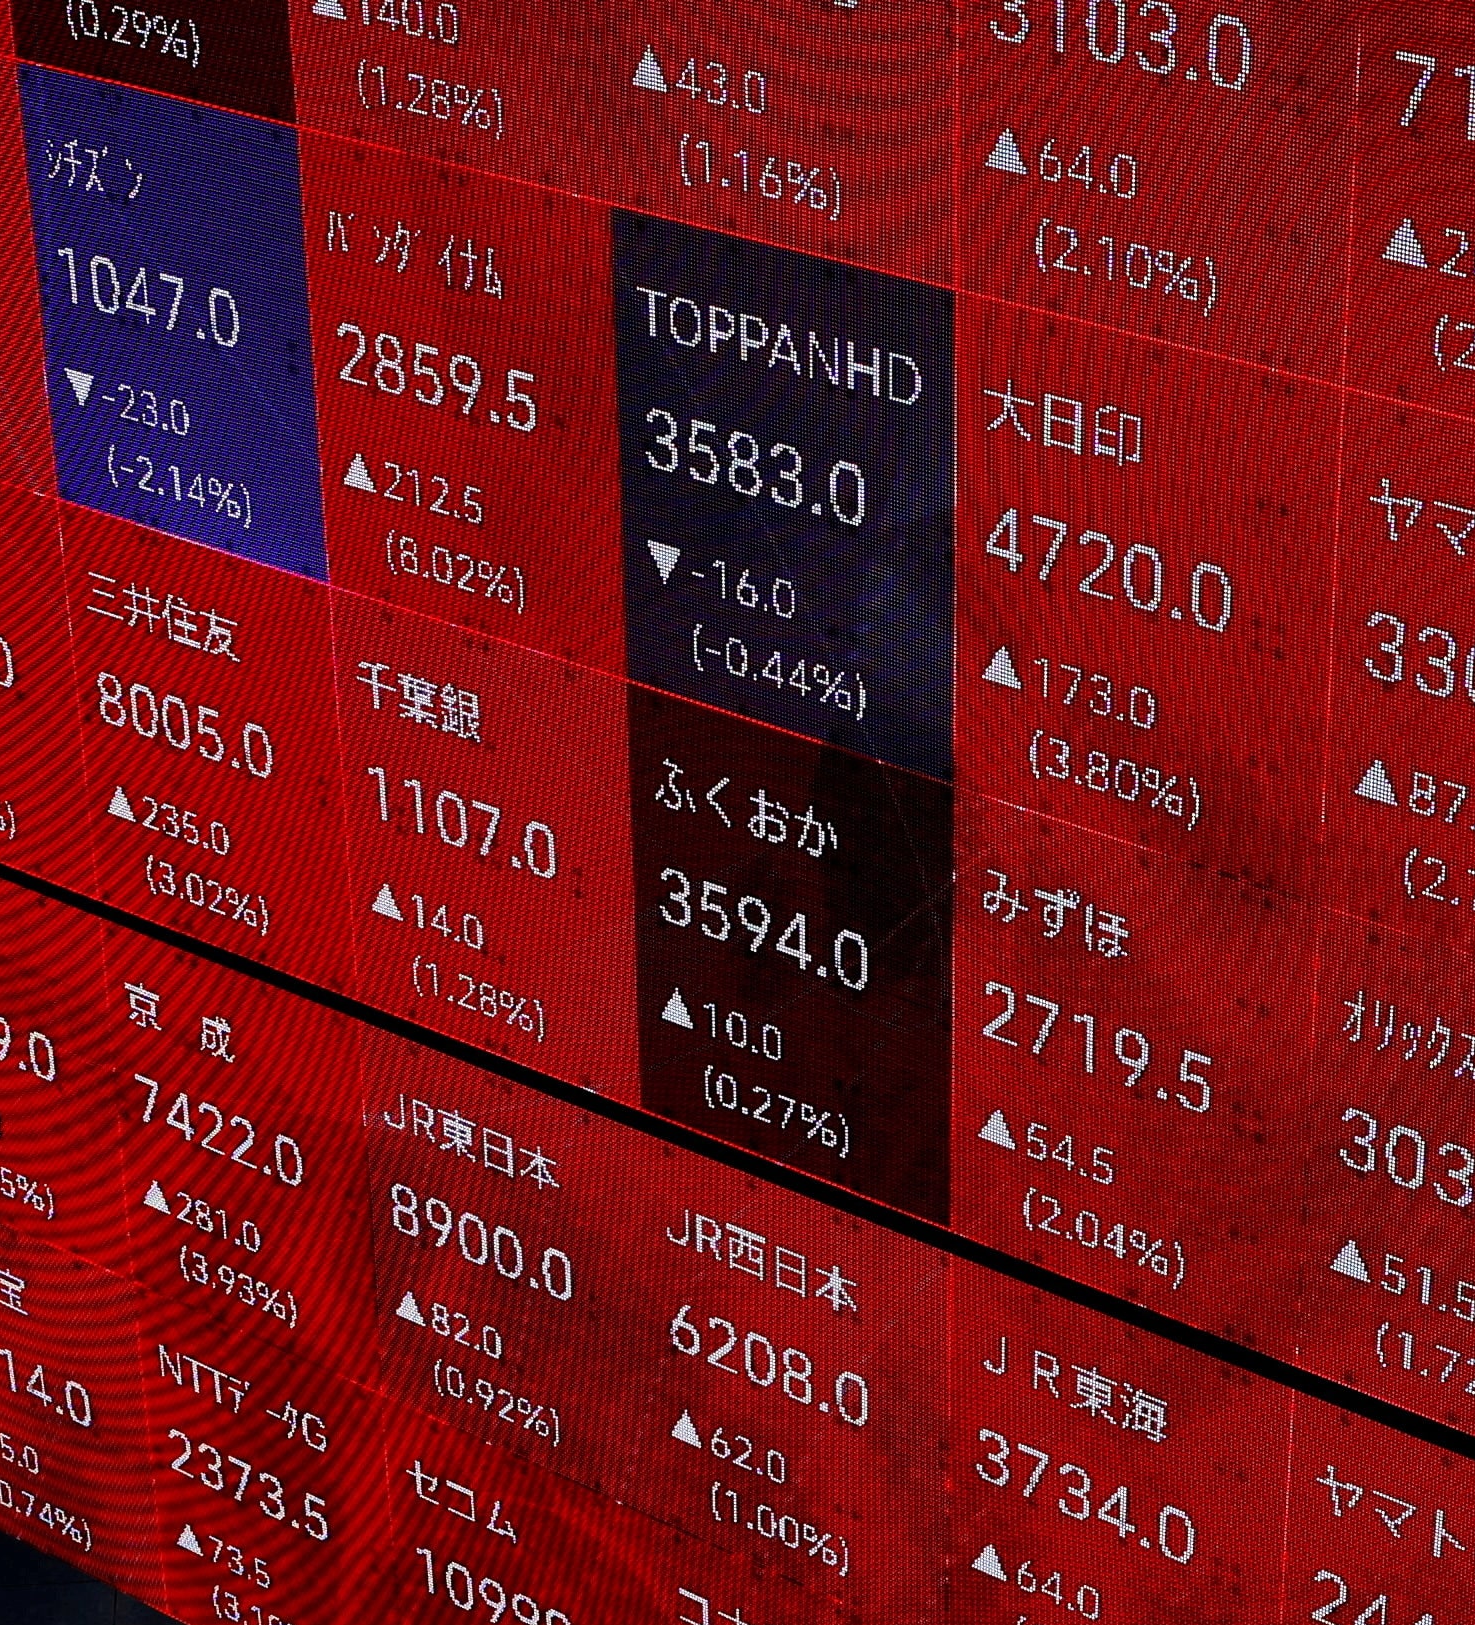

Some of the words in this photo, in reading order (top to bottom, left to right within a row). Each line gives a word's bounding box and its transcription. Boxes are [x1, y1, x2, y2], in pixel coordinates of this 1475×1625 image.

[57, 247, 240, 348] 1047.0
[636, 286, 922, 405] TOPPANHD
[103, 384, 190, 436] -23.0
[336, 322, 537, 432] 2859.5
[984, 380, 1141, 465] 大日印
[107, 445, 252, 529] (-2.14%)
[384, 461, 482, 524] 212.5
[646, 408, 865, 526] 3583.0
[87, 571, 239, 662] 三井住友
[386, 531, 524, 614] (8.02%)
[692, 560, 795, 619] -16.0
[986, 508, 1232, 633] 4720.0
[356, 661, 483, 743] 千葉銀
[693, 623, 867, 721] (-0.44%)
[97, 671, 274, 779] 8005.0
[367, 766, 557, 879] 1107.0
[654, 758, 838, 858] ふくおか
[660, 867, 869, 991] 3594.0
[983, 869, 1129, 958] みずほ
[982, 981, 1212, 1113] 2719.5
[134, 1073, 304, 1187] 7422.0
[382, 1095, 559, 1188] JR東日本
[390, 1183, 573, 1301] 8900.0
[666, 1210, 859, 1312] JR西日本
[670, 1304, 869, 1427] 6208.0
[168, 1428, 329, 1541] 2373.5
[406, 1460, 517, 1542] セコム
[976, 1428, 1195, 1564] 3734.0
